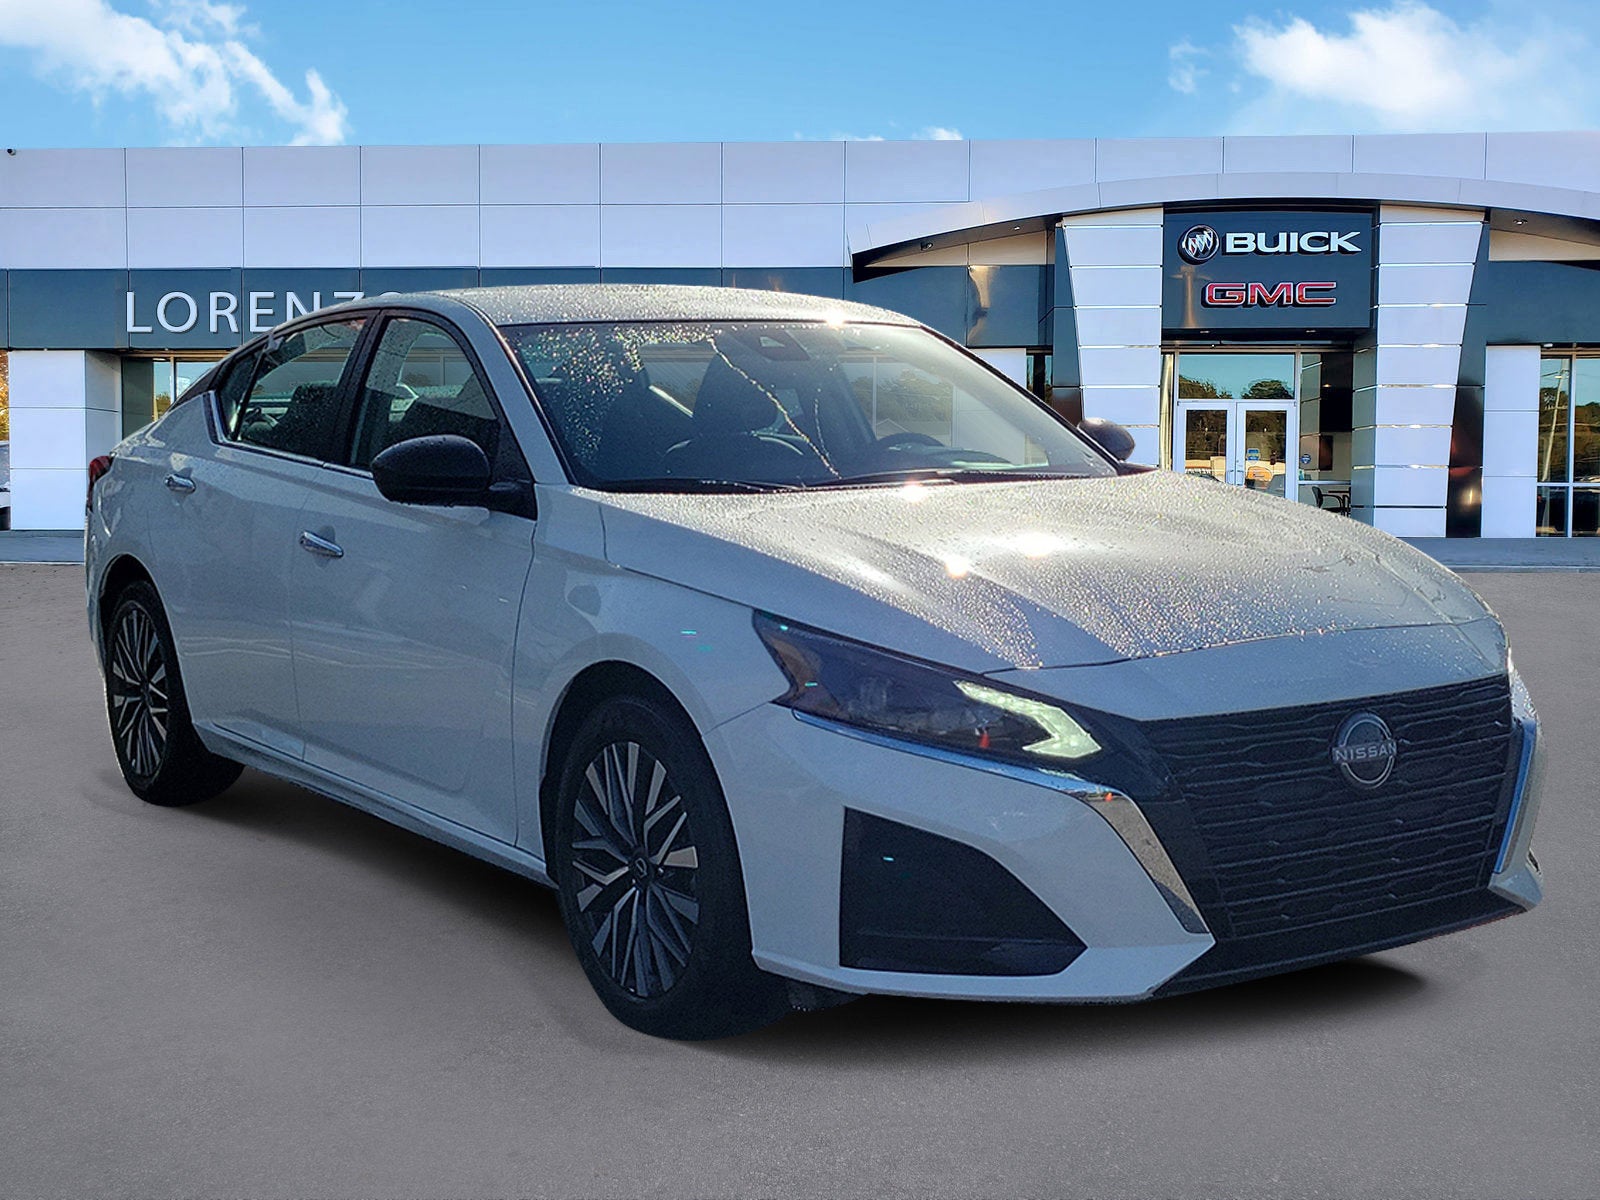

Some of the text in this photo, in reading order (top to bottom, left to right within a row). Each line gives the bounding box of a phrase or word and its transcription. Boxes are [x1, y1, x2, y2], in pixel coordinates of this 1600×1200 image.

[1226, 231, 1362, 253] BUICK
[1206, 282, 1337, 306] GMC
[126, 291, 402, 333] LOREN
[1333, 741, 1397, 761] NISSAN
